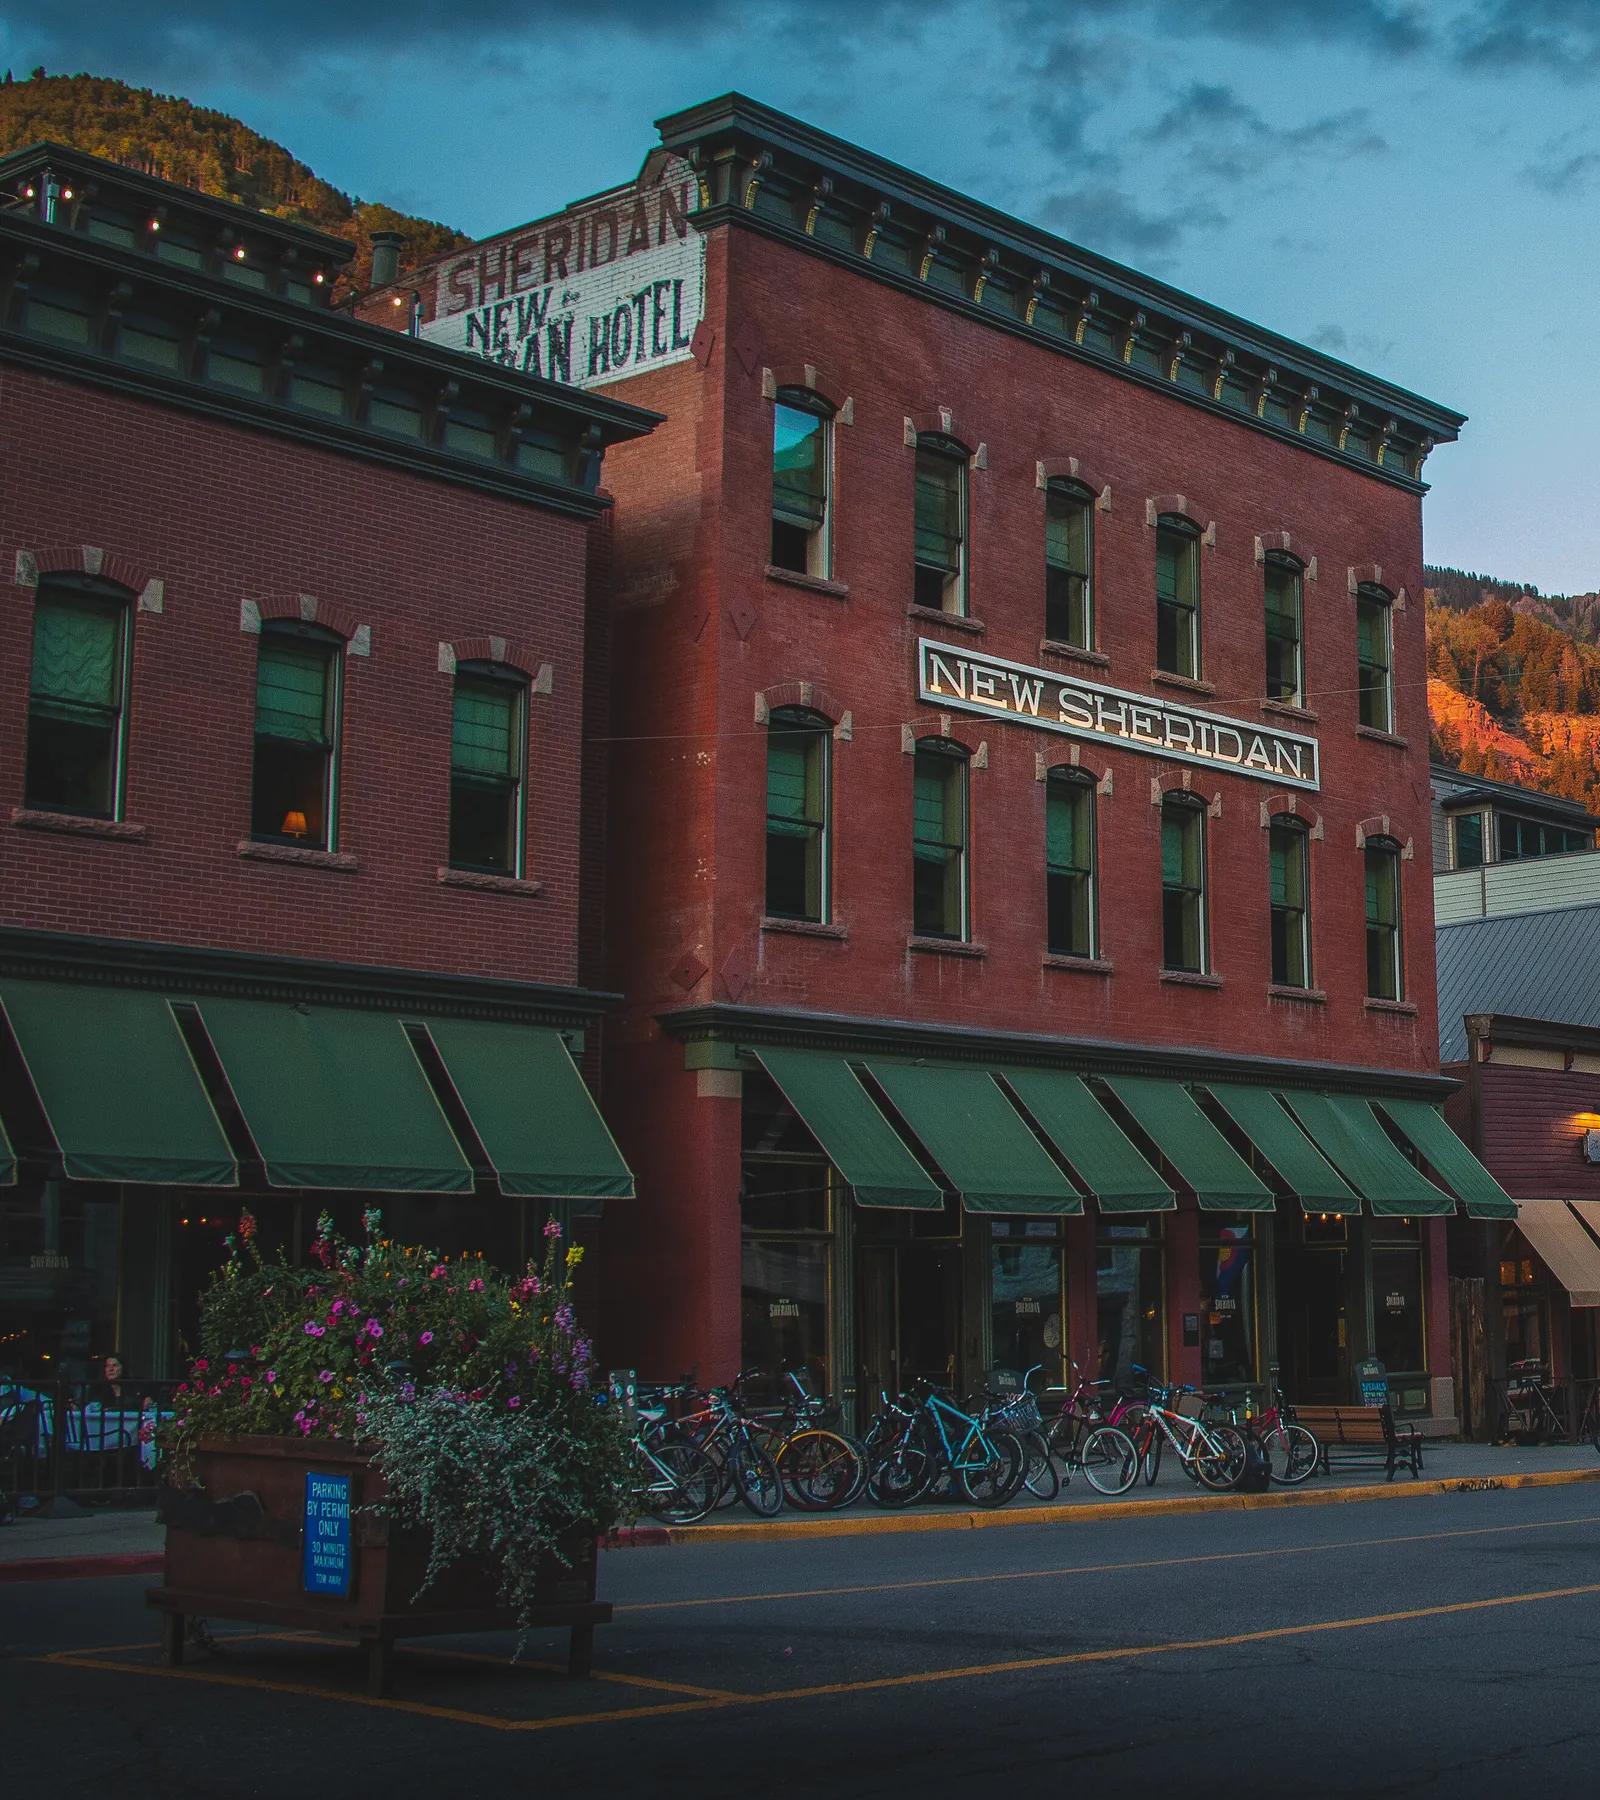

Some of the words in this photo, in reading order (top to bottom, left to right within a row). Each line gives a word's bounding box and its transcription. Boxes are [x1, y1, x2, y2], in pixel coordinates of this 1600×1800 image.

[447, 184, 690, 312] SHERIDAN
[464, 286, 554, 356] NEW
[588, 278, 691, 378] HOTEL
[929, 652, 1045, 716] NEW
[312, 1482, 347, 1500] PARKING
[307, 1501, 319, 1516] BY
[321, 1503, 350, 1519] PERMIT
[318, 1520, 339, 1537] ONLY
[312, 1541, 321, 1553] 30
[323, 1543, 346, 1556] MINUTE
[313, 1557, 344, 1569] MAXIMUM
[316, 1573, 327, 1584] TOW
[328, 1575, 341, 1586] AWAY
